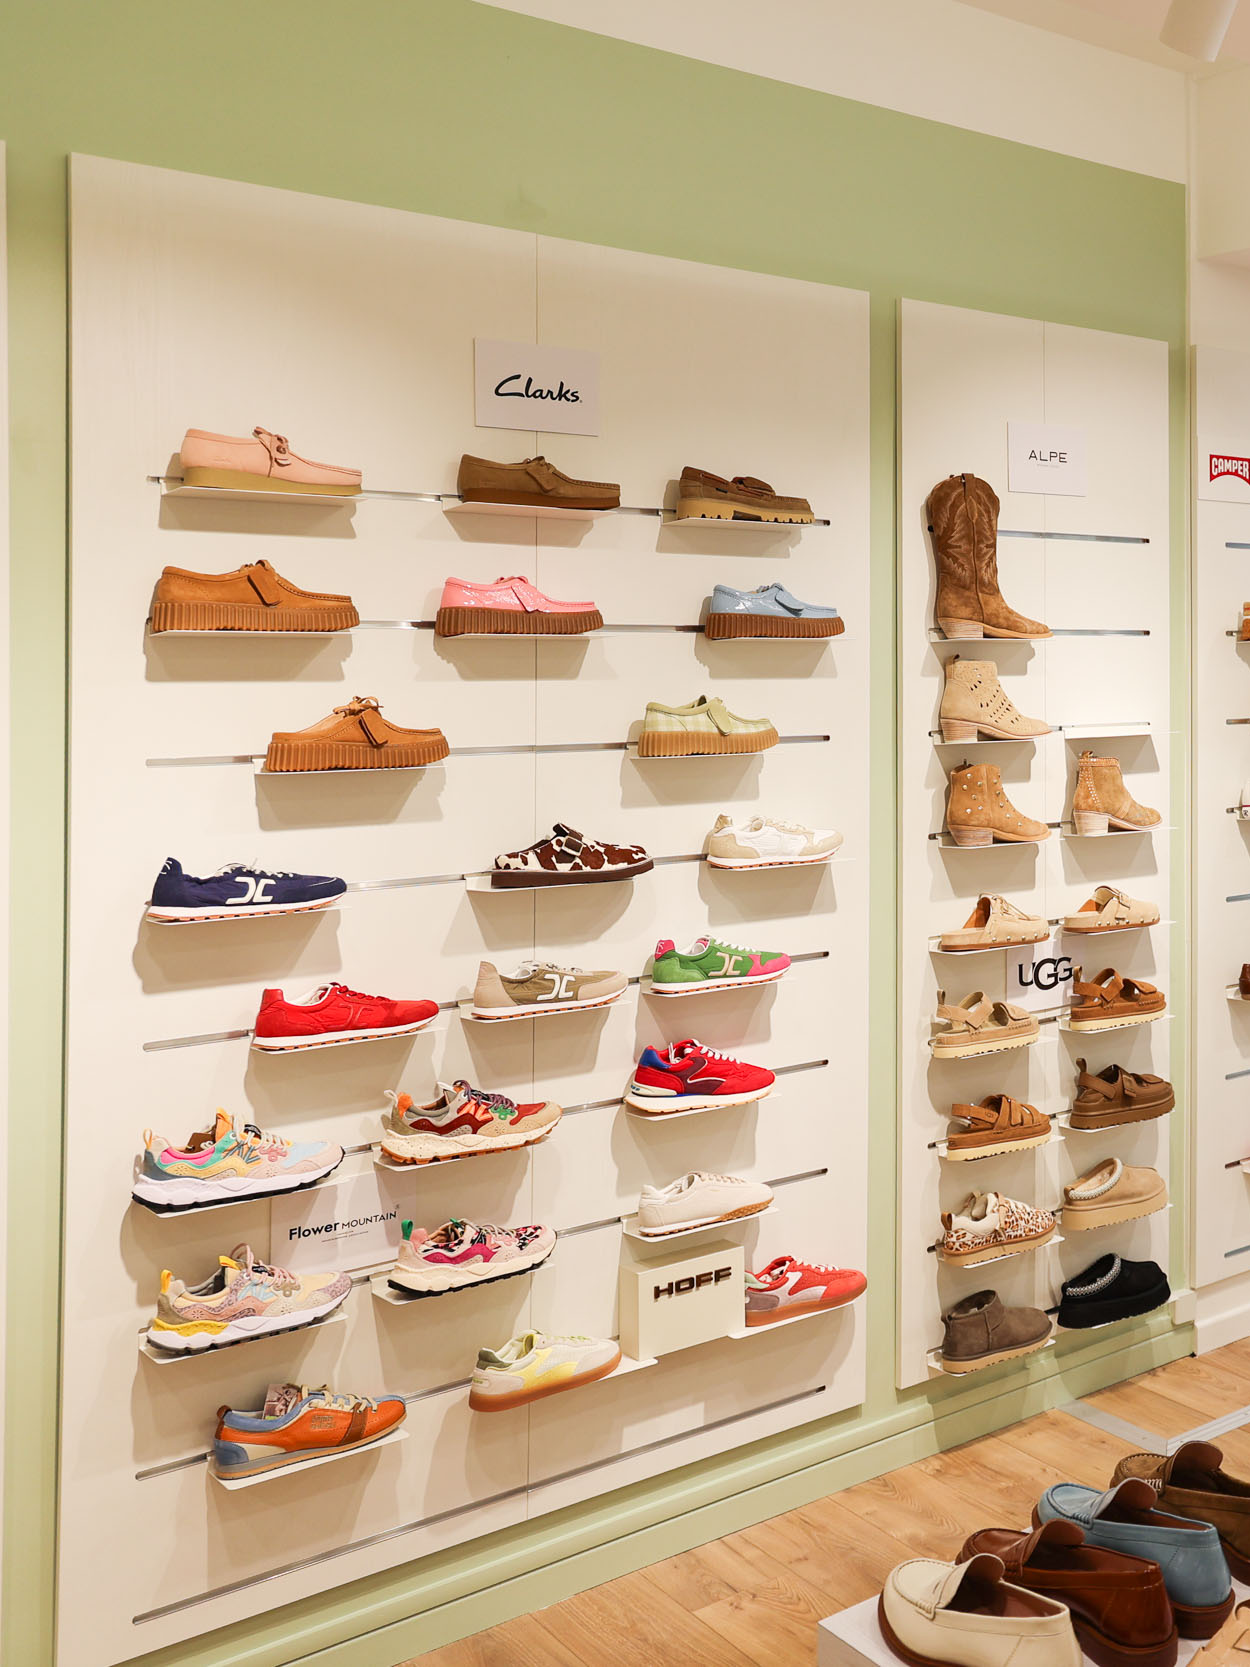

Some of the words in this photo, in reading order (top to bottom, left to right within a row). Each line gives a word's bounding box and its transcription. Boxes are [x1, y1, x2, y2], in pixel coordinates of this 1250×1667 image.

[1028, 449, 1068, 464] ALPE
[1211, 457, 1250, 480] CAMPER
[1018, 956, 1074, 991] UGG
[289, 1221, 340, 1241] Flower
[341, 1211, 397, 1230] MOUNTAIN
[654, 1266, 732, 1300] HOFF
